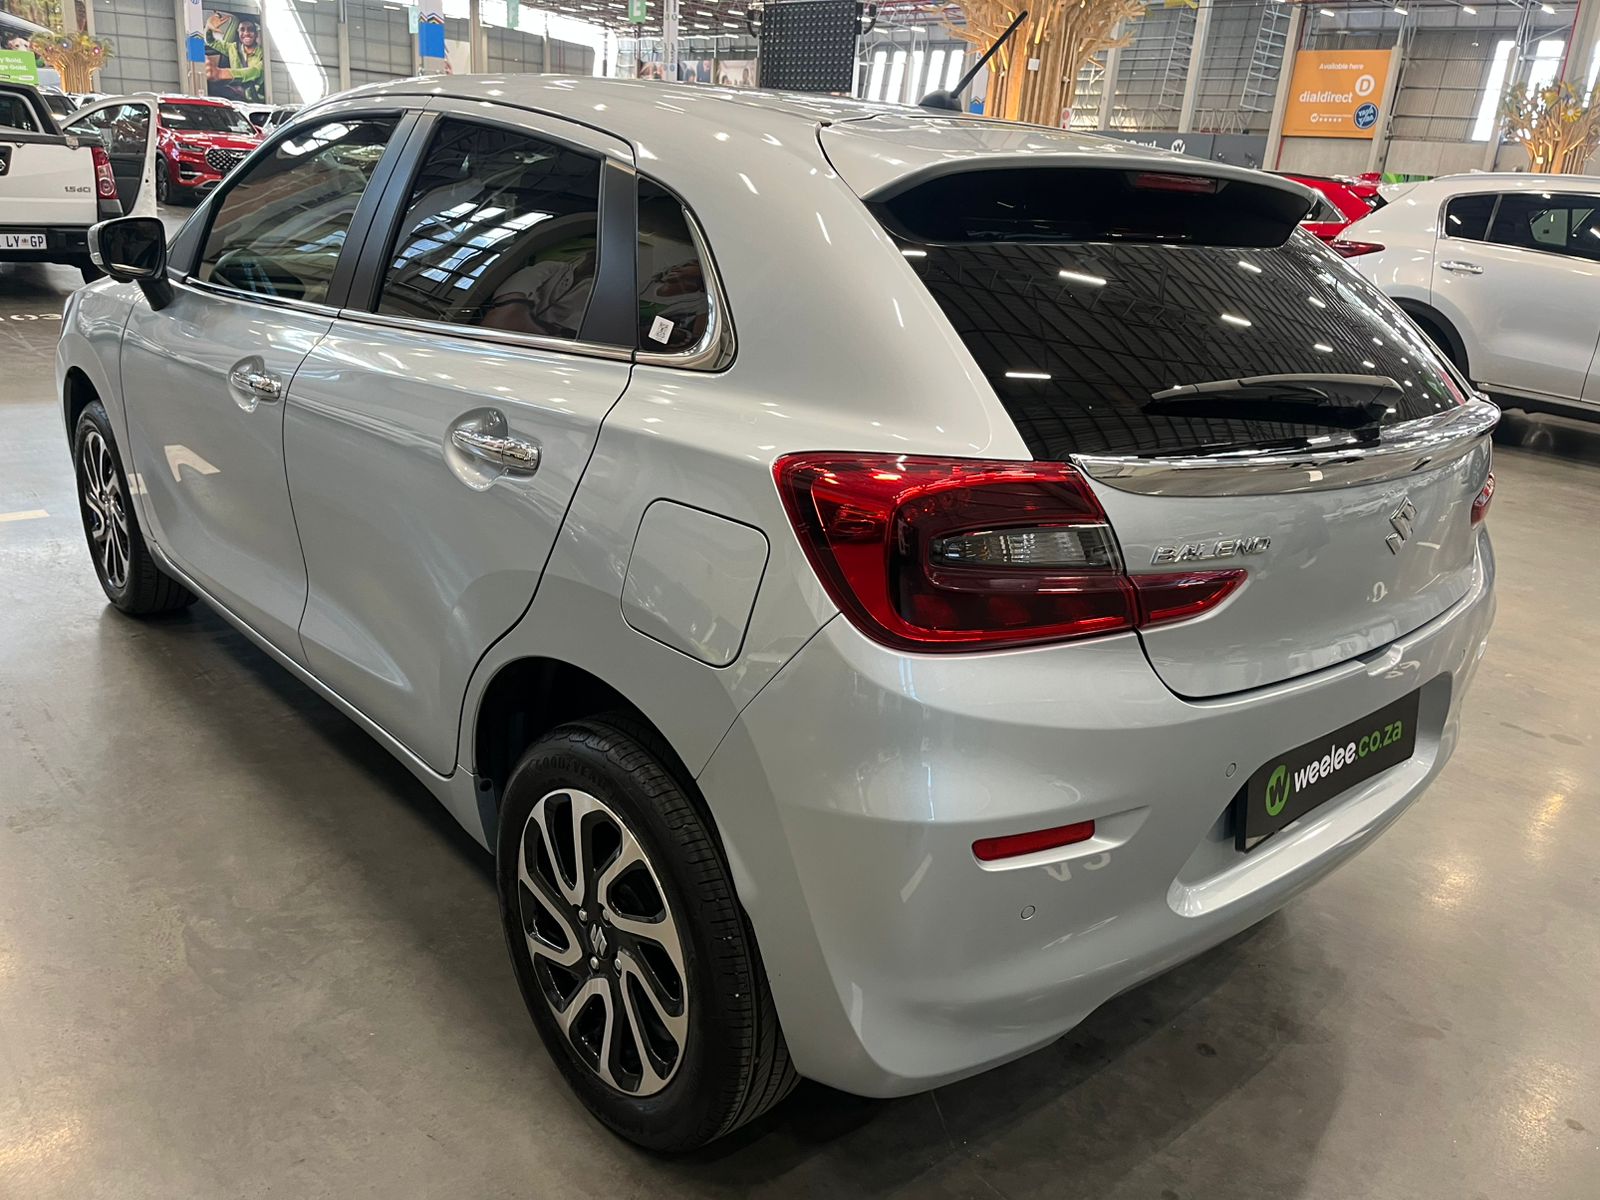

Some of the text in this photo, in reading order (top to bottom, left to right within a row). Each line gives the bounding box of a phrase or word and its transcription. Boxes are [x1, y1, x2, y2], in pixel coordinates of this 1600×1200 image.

[1319, 62, 1348, 70] Available
[1299, 90, 1354, 103] dialdirect
[6, 235, 44, 248] LY GP
[1151, 536, 1272, 564] BALENO
[1293, 720, 1403, 793] weelee.co.za
